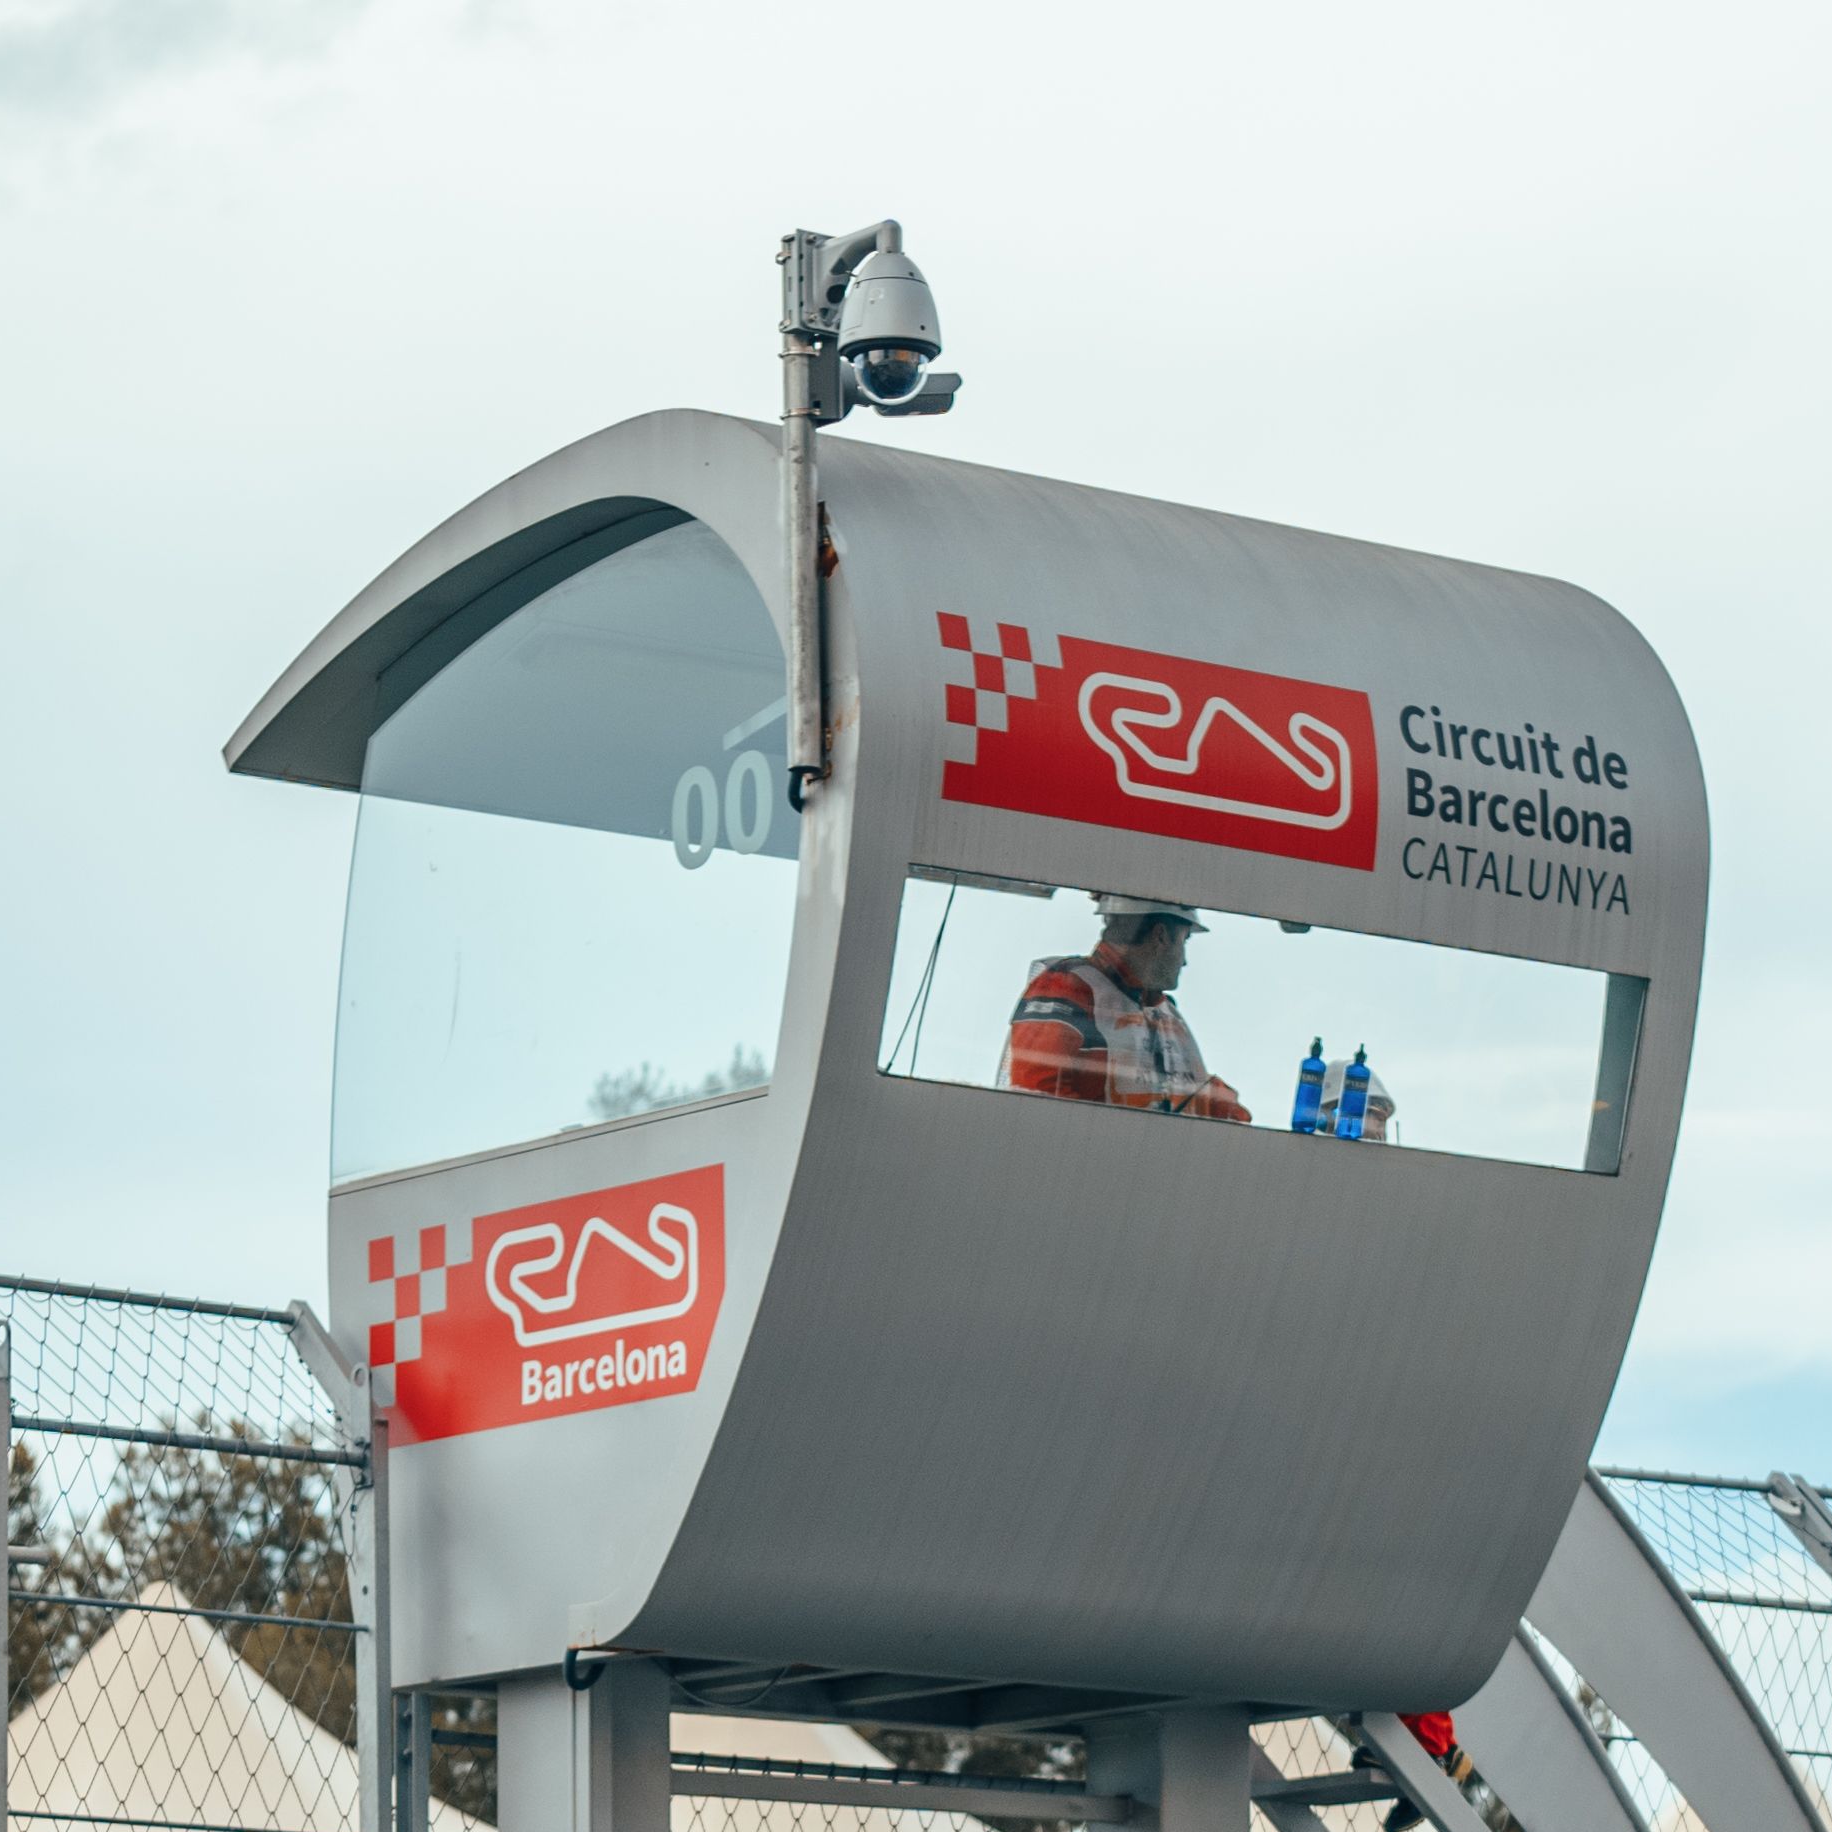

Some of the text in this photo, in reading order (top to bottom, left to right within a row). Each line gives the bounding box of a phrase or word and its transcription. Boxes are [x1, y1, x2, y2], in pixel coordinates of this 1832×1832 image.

[1399, 704, 1629, 790] Circuit de
[1406, 767, 1632, 855] Barcelona
[1402, 837, 1630, 916] CATALUNYA
[520, 1338, 687, 1406] Barcelona
